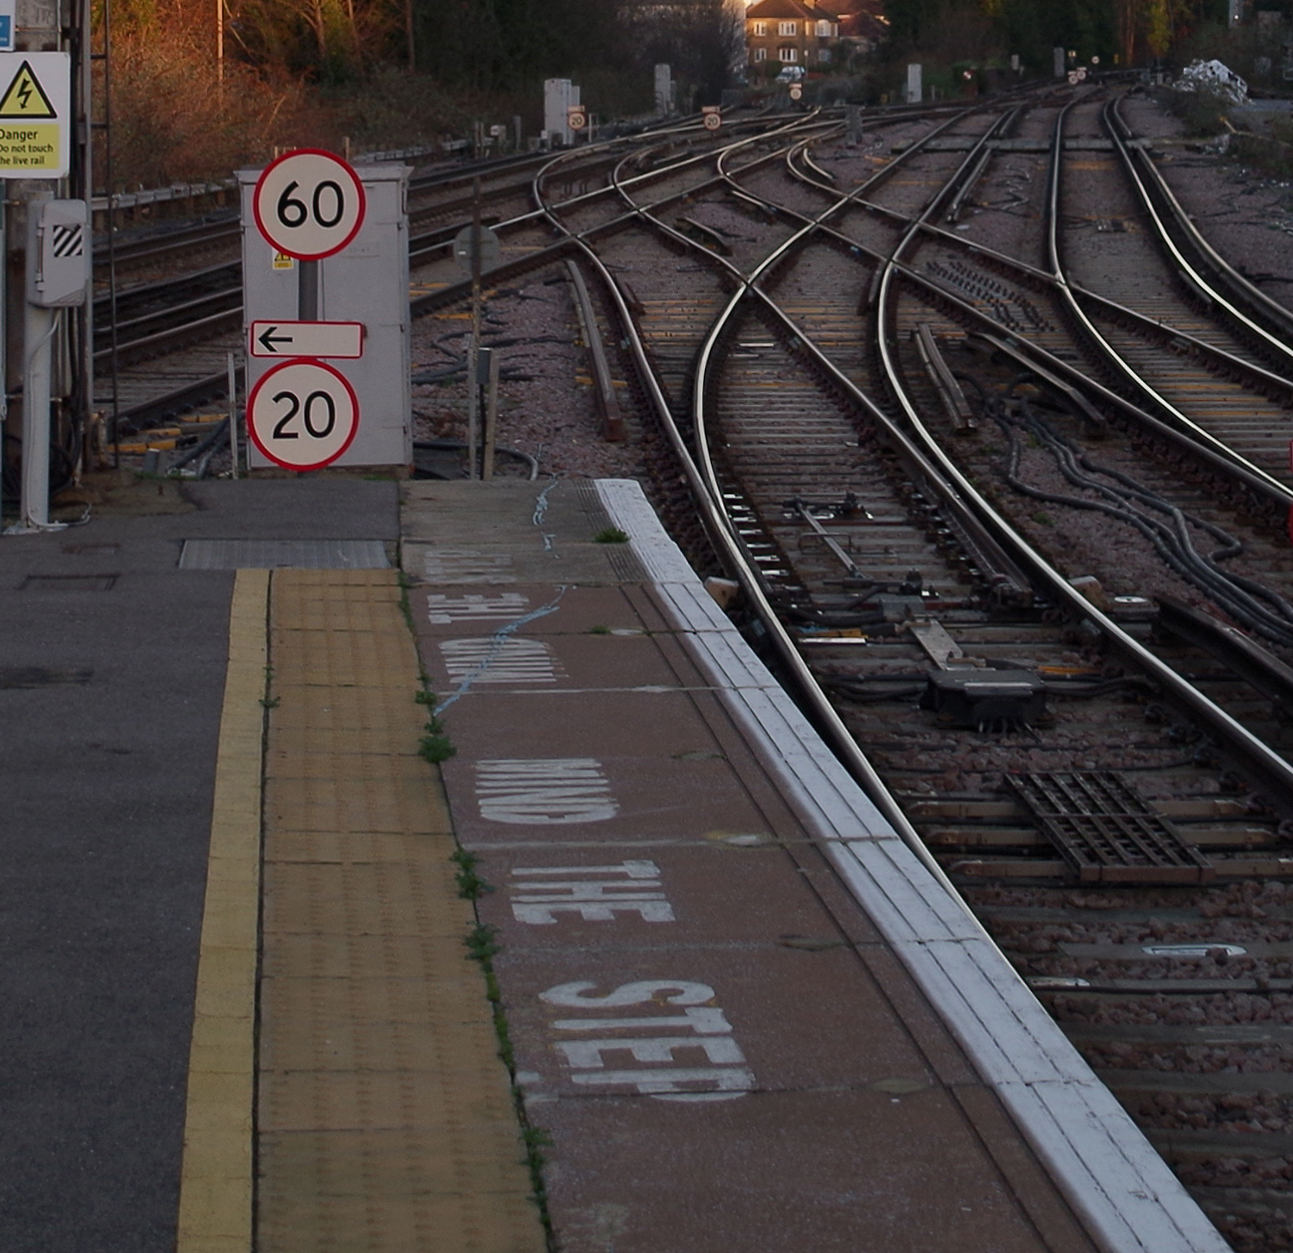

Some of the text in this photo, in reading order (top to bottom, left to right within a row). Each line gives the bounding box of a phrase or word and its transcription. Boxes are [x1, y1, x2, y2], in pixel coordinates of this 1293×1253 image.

[571, 116, 583, 126] 20
[707, 117, 718, 126] 20
[11, 144, 26, 153] not
[28, 144, 54, 153] touch
[12, 156, 29, 165] live
[30, 156, 45, 165] rail
[277, 179, 345, 229] 60
[271, 390, 336, 440] 20
[426, 592, 530, 624] THE
[474, 758, 756, 1102] MIND THE STEP
